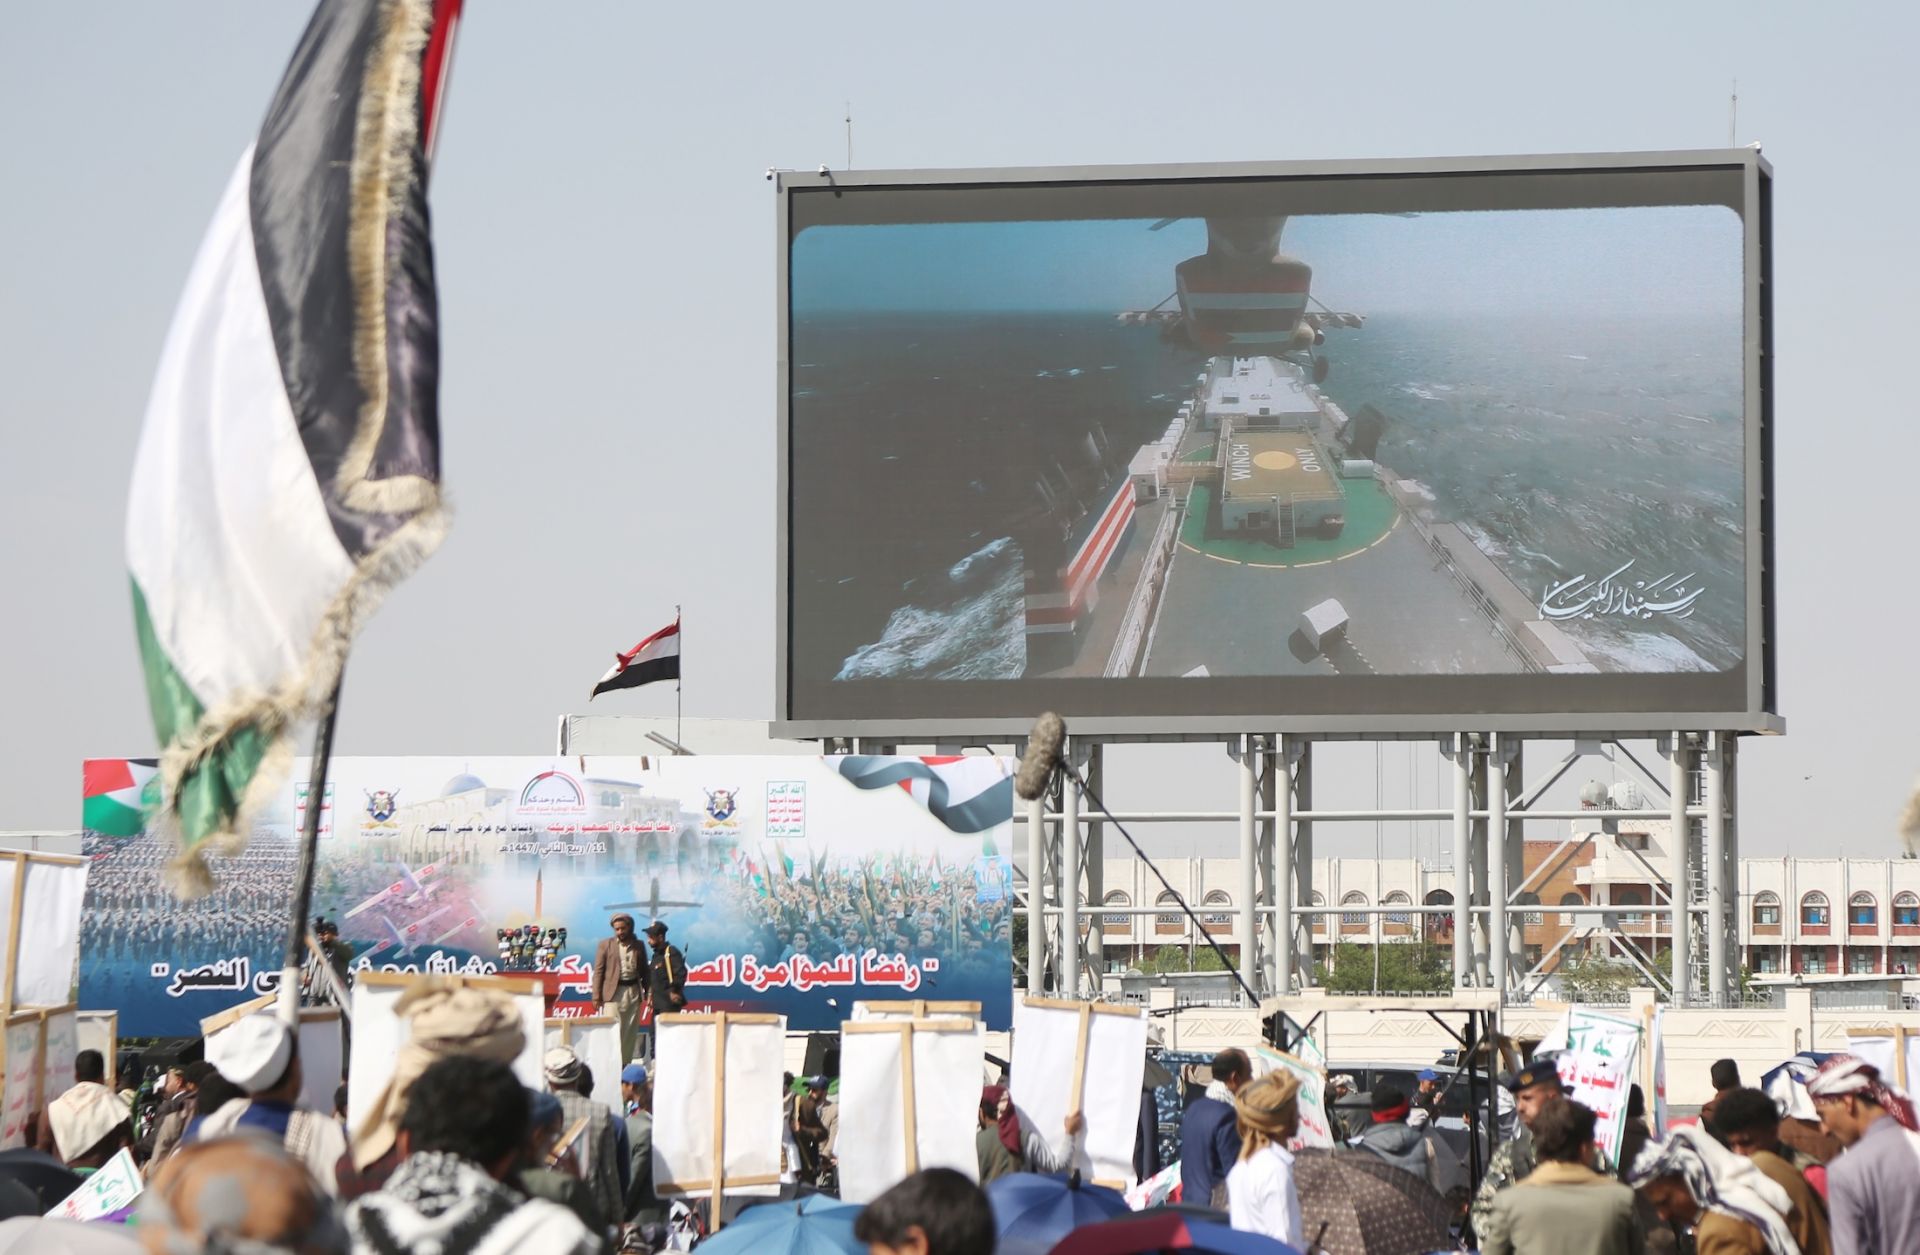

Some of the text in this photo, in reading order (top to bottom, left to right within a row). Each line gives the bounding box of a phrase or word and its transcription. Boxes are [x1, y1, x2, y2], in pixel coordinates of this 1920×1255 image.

[1231, 443, 1251, 481] WINCH
[1296, 447, 1321, 473] ONLY
[741, 955, 855, 991] للمؤامرة
